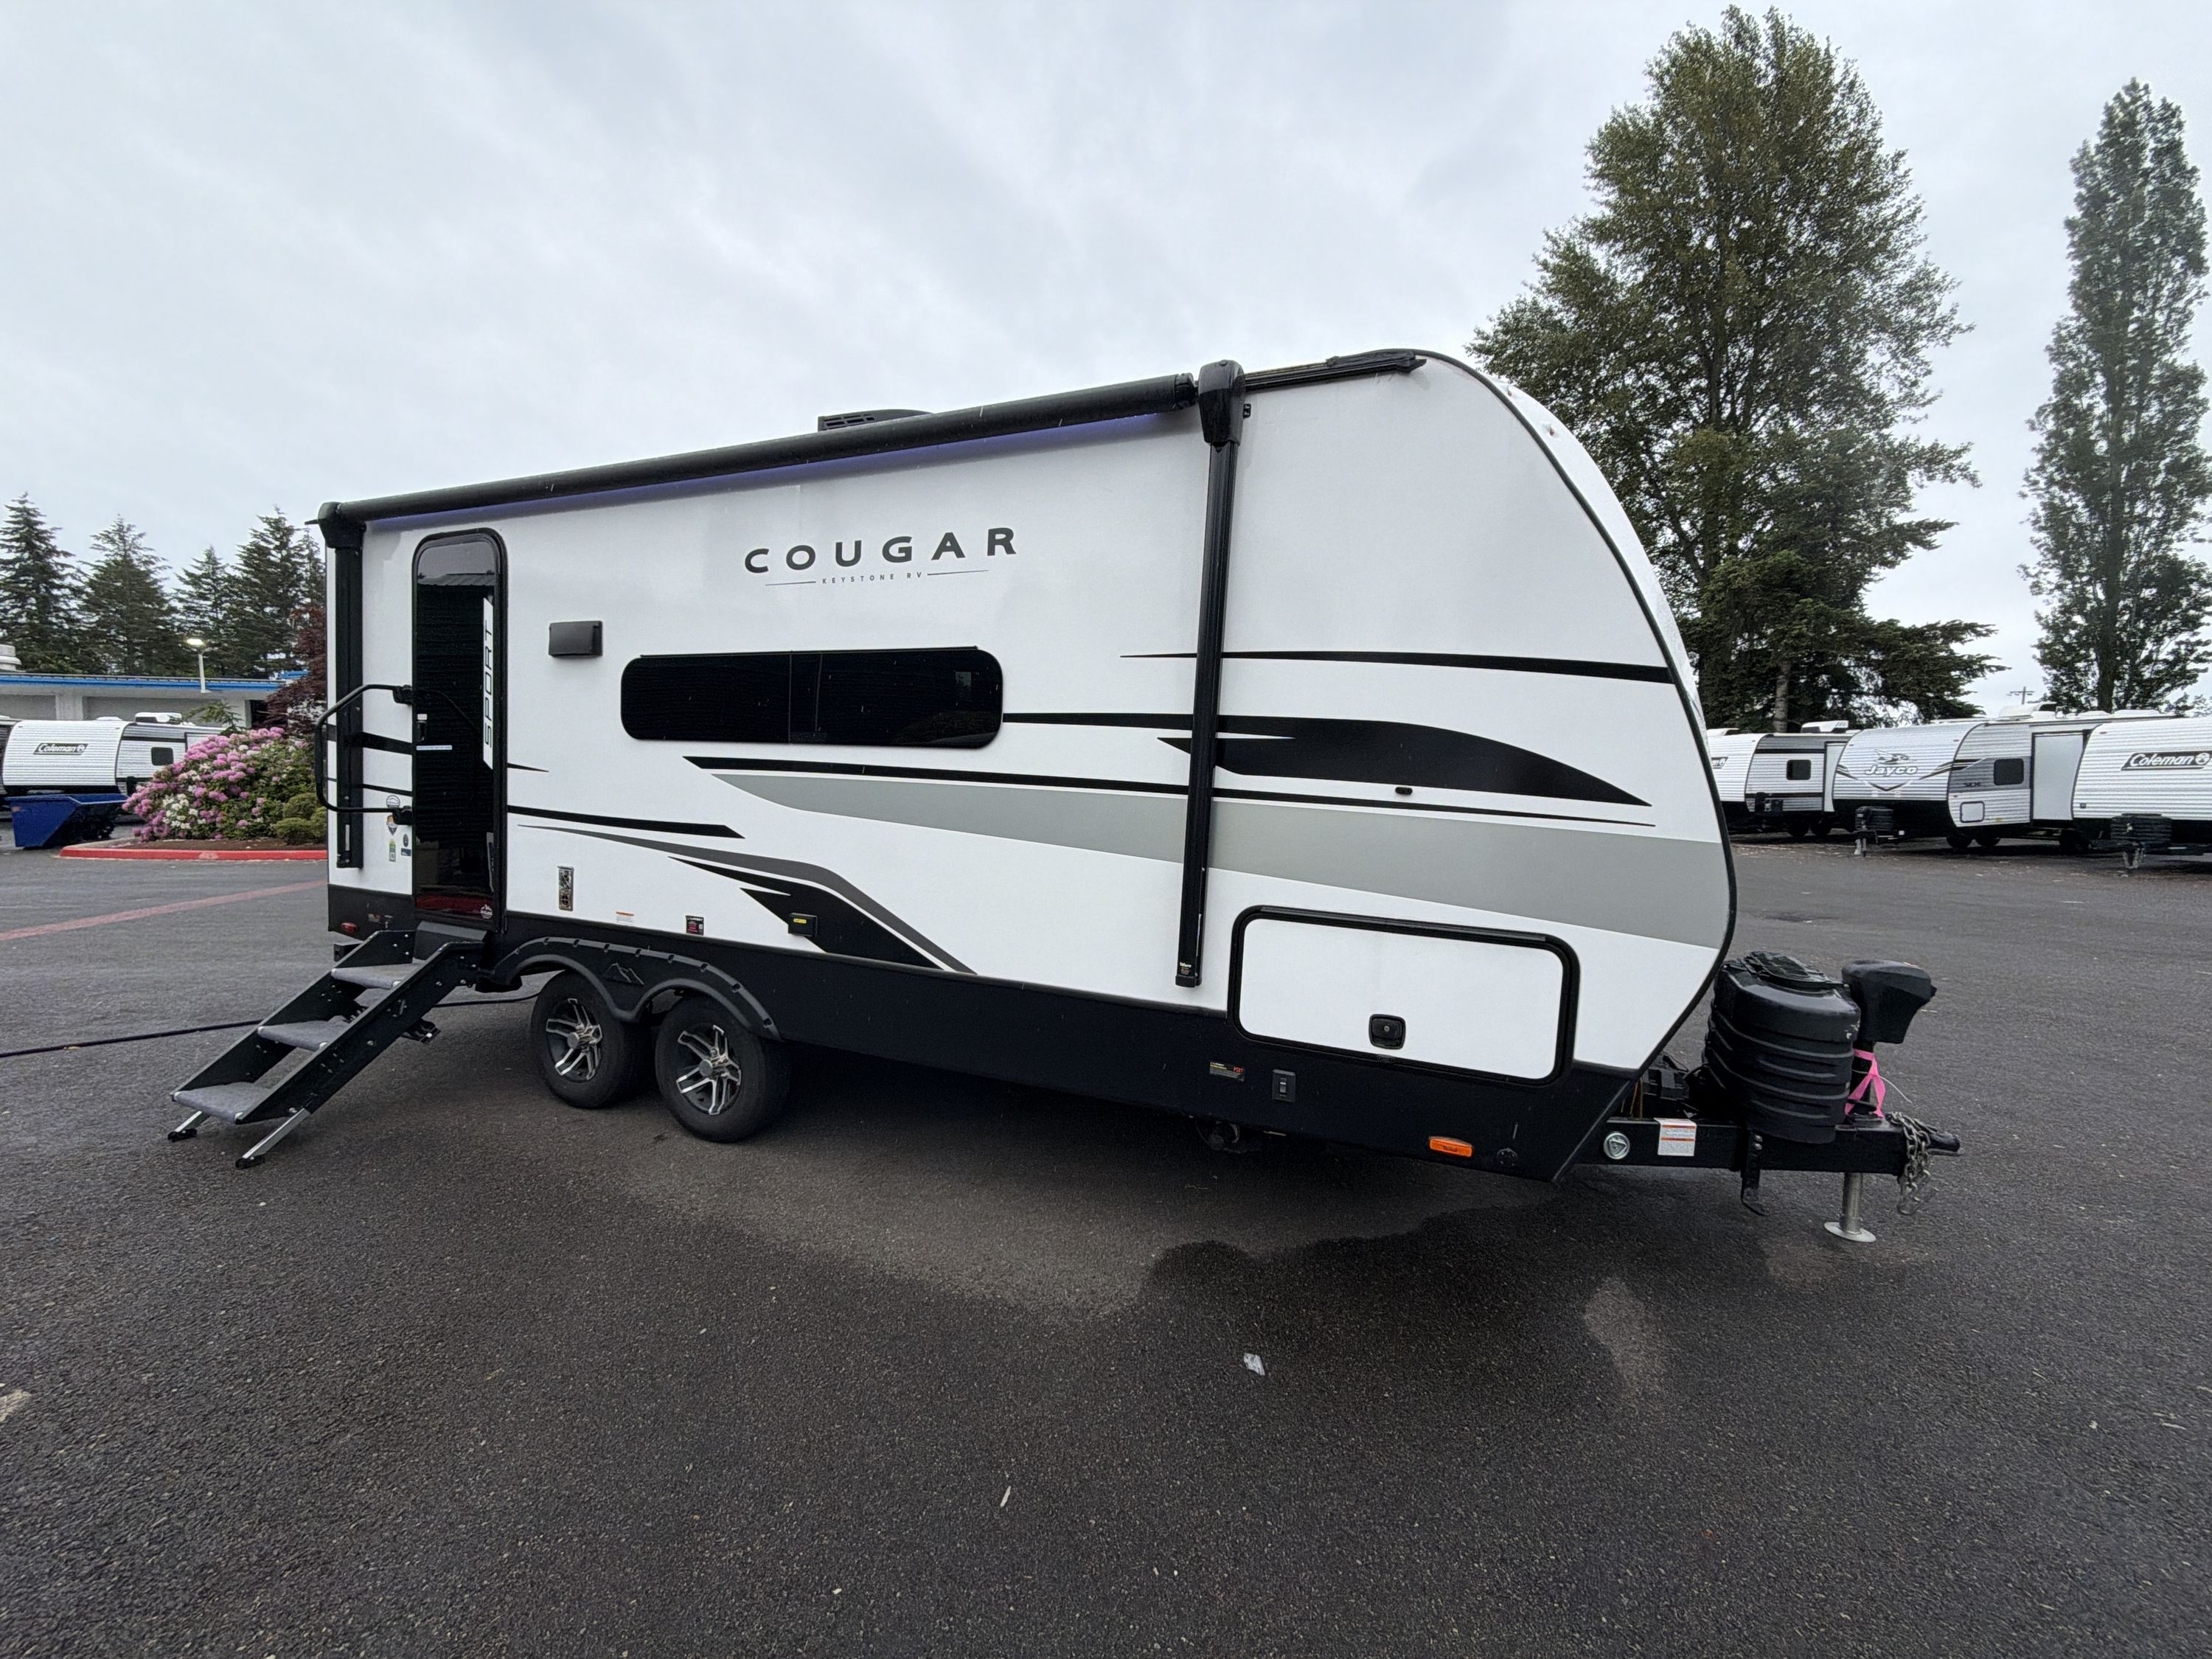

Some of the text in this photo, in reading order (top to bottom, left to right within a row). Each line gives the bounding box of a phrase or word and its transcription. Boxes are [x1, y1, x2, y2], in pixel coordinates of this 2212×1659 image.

[744, 526, 1017, 574] COUGAR
[822, 571, 923, 585] KEYSTONE RV
[484, 619, 493, 748] SPORT
[38, 743, 77, 752] Coleman
[2129, 753, 2194, 767] Coleman
[1865, 765, 1919, 777] Jayco
